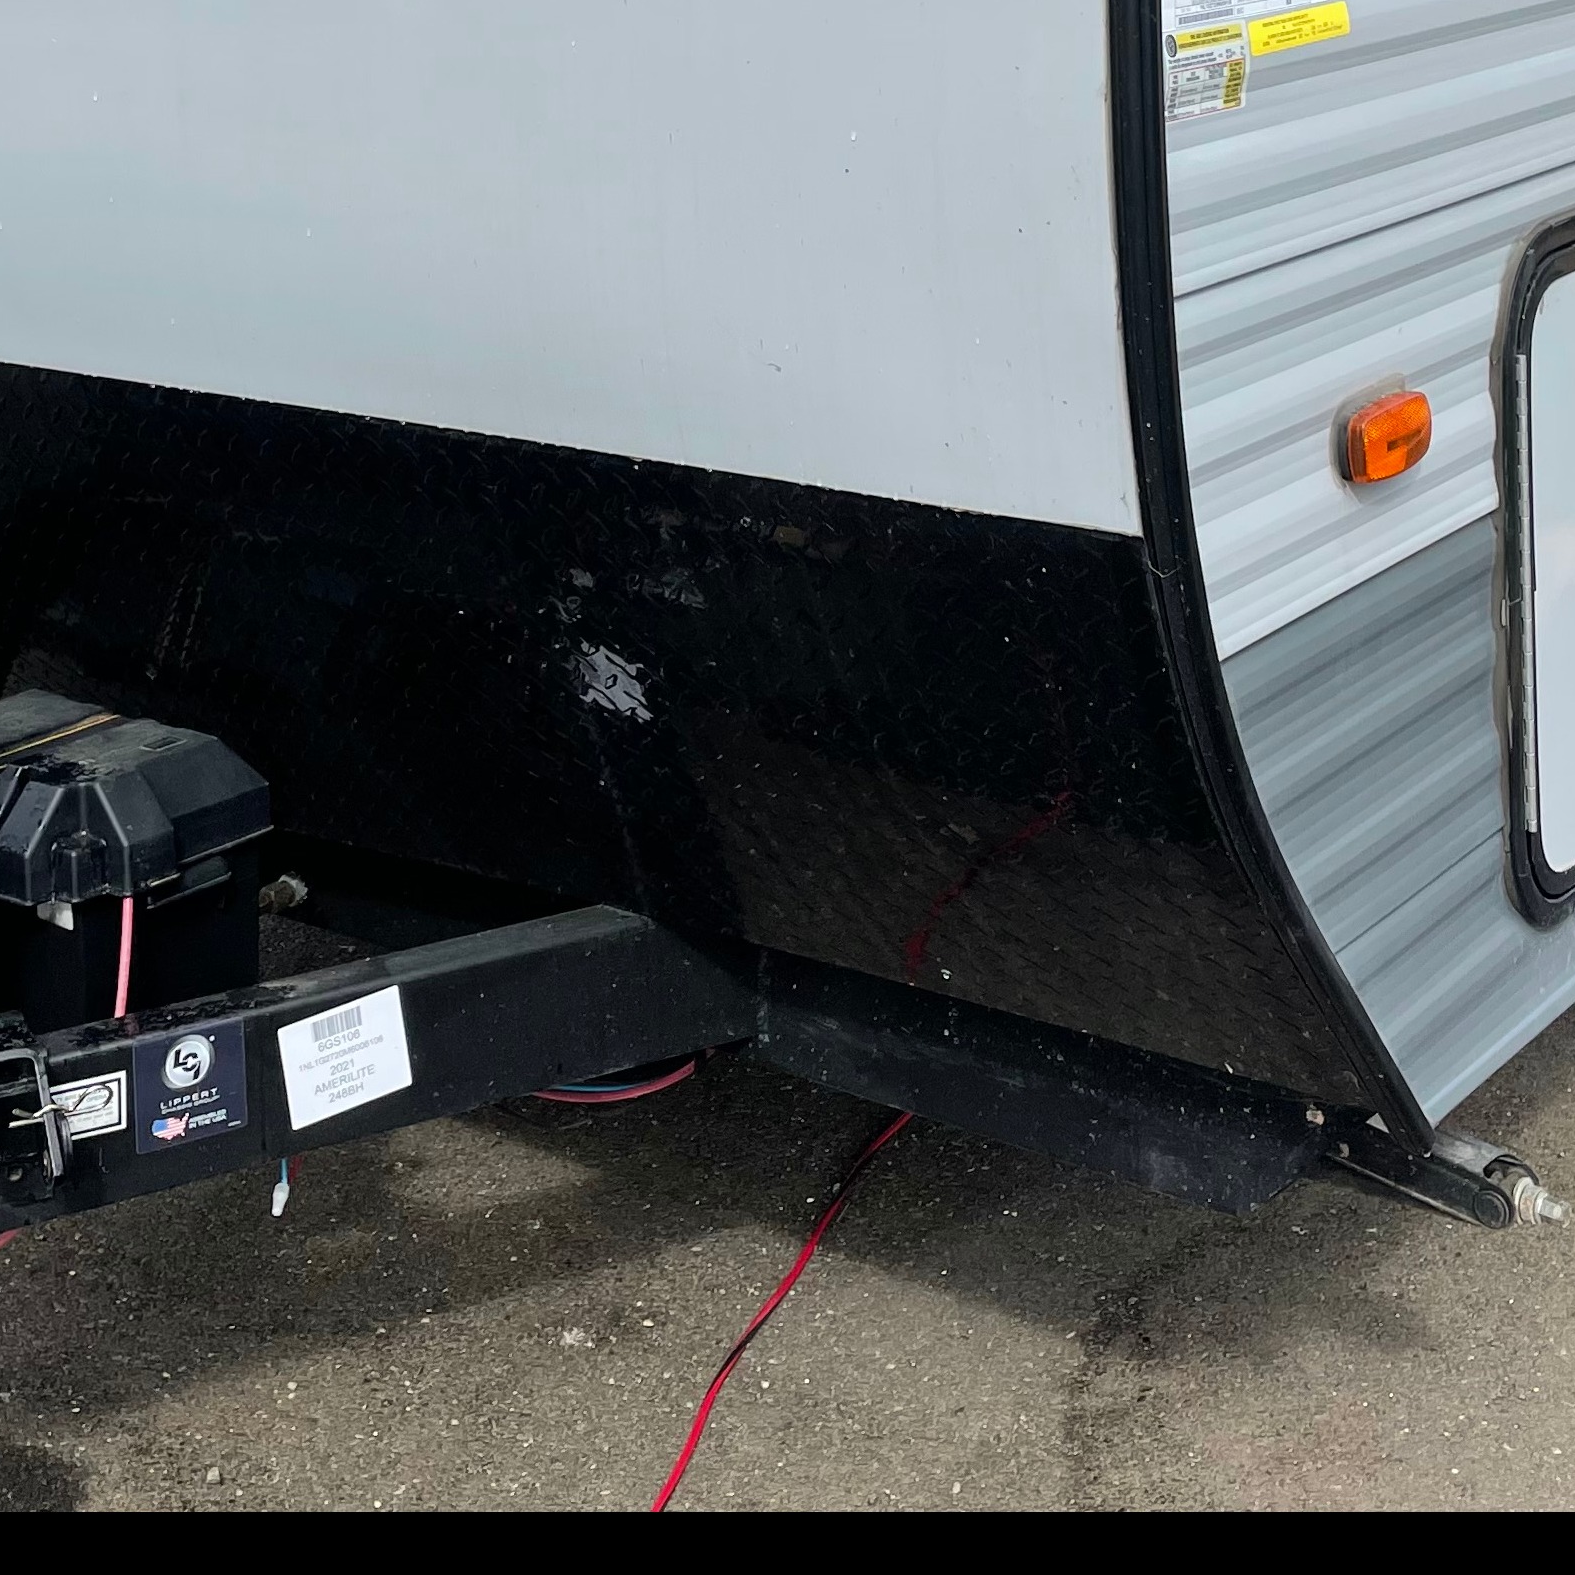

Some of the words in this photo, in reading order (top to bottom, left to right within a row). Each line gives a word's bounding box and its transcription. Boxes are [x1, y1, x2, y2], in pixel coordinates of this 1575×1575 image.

[329, 1058, 356, 1077] 2021
[314, 1063, 376, 1096] AMERILITE
[159, 1087, 218, 1110] LIPPERT
[328, 1082, 365, 1104] 248BH
